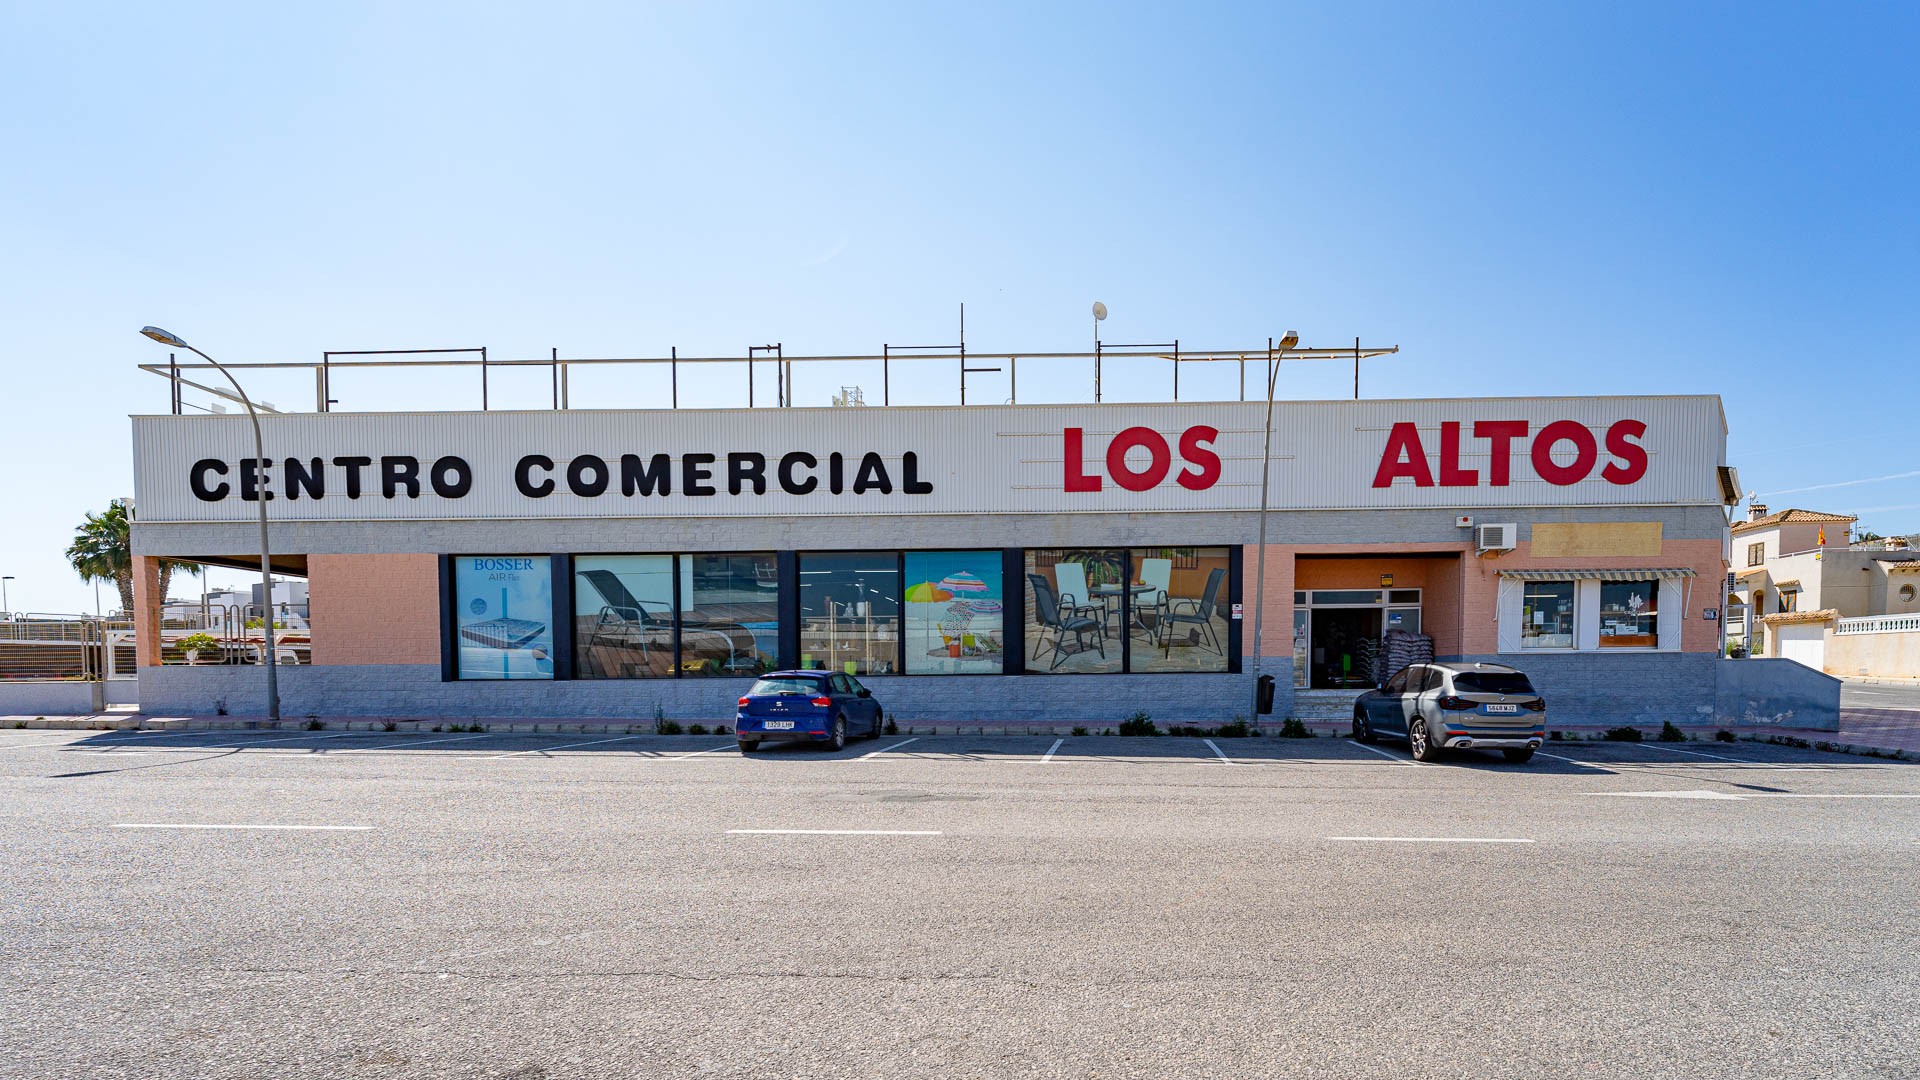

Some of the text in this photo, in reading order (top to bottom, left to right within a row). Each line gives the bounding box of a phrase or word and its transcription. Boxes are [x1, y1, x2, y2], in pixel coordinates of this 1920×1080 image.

[189, 418, 1648, 502] CENTRO COMERCIAL LOS ALTOS
[474, 558, 534, 571] BOSSER
[488, 573, 506, 581] AIR
